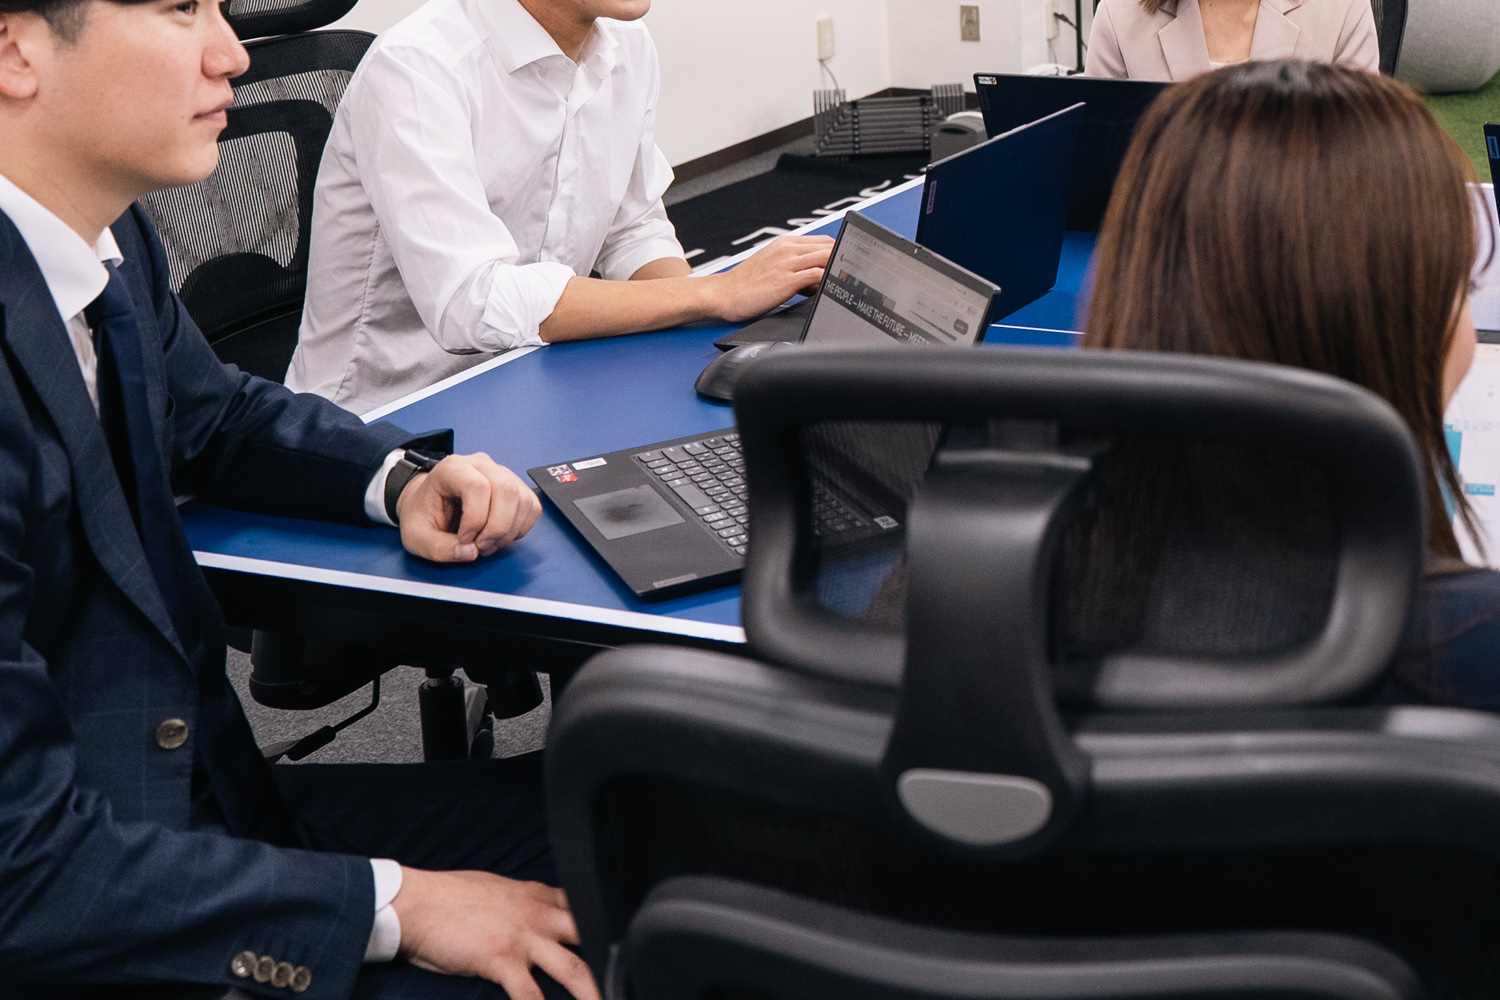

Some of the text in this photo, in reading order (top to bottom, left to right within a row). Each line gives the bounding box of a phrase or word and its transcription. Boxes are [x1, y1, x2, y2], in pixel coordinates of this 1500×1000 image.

[825, 279, 835, 293] THE
[833, 285, 854, 305] PEOPLE
[856, 299, 874, 317] MAKE
[872, 308, 884, 323] THE
[882, 315, 905, 336] FUTURE
